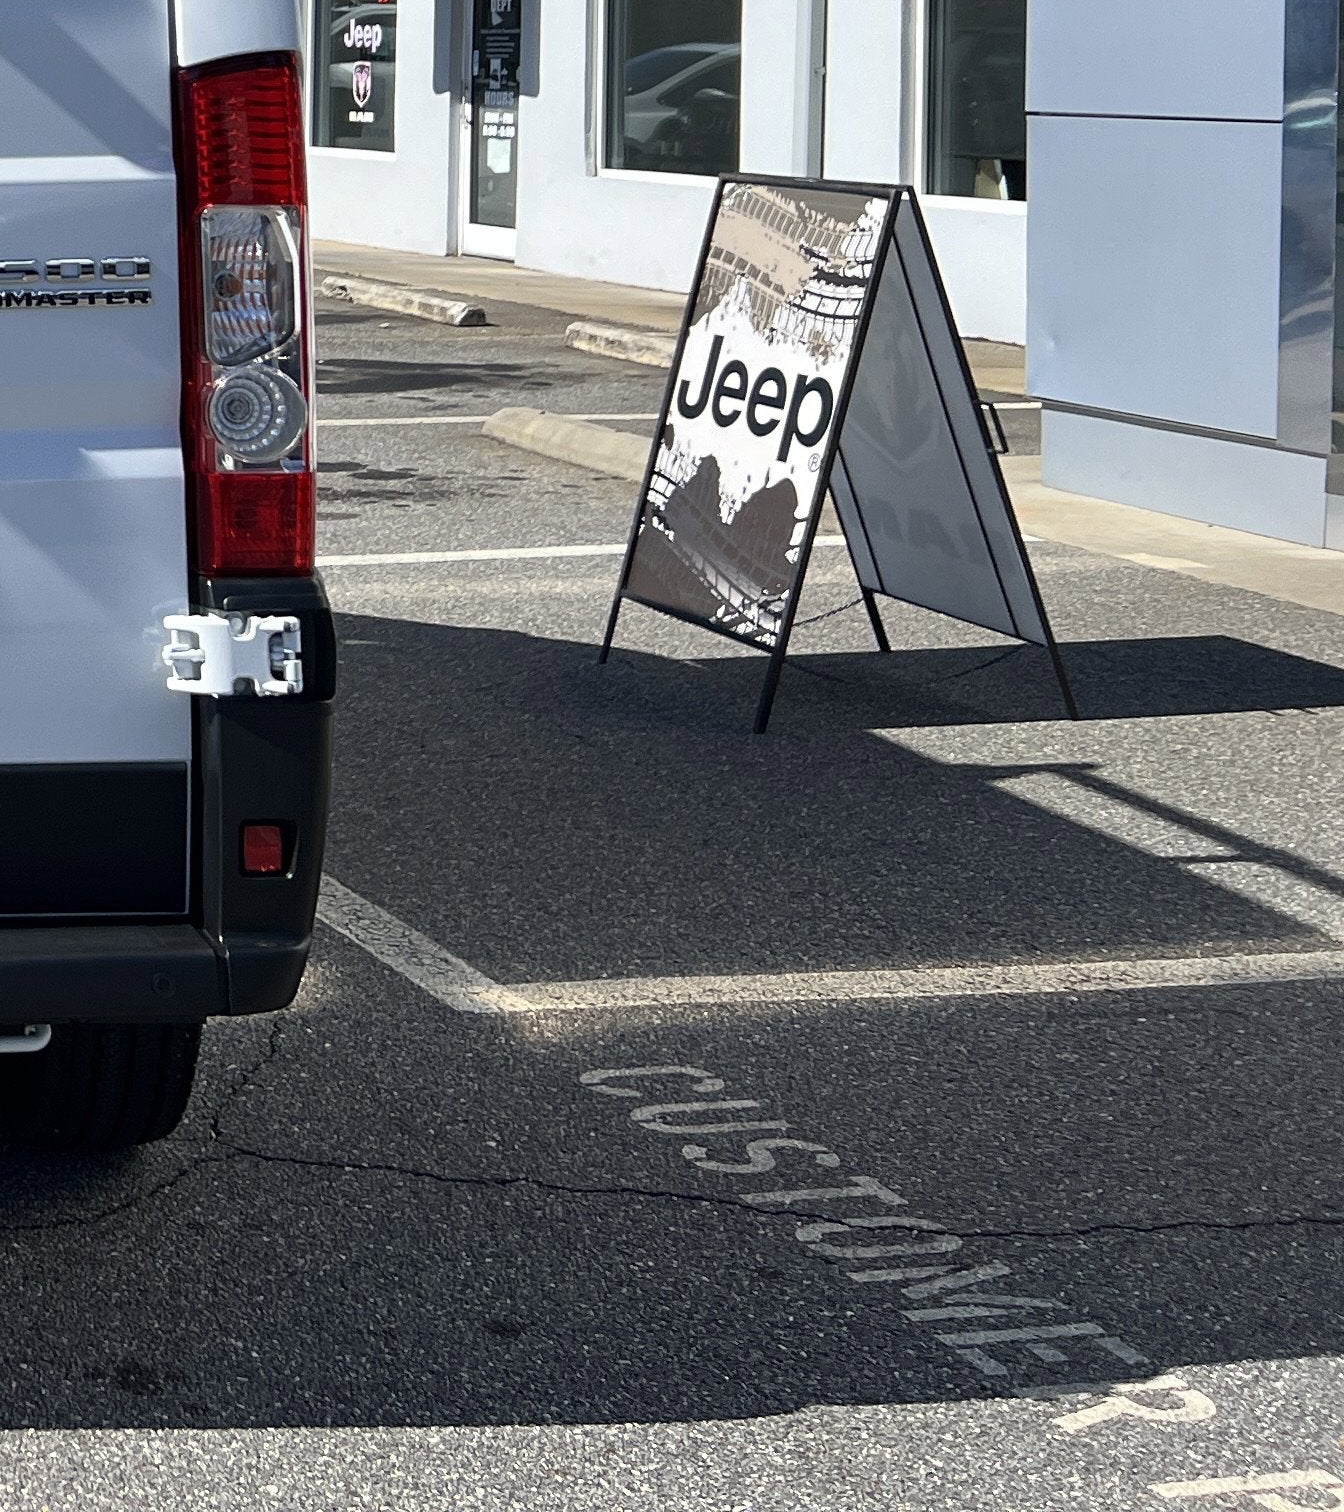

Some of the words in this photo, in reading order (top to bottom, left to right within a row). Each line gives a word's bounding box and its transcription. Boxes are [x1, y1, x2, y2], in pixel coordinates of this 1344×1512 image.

[343, 18, 382, 53] Jeep
[677, 335, 834, 462] Jeep
[579, 1065, 1217, 1434] CUSTOMER
